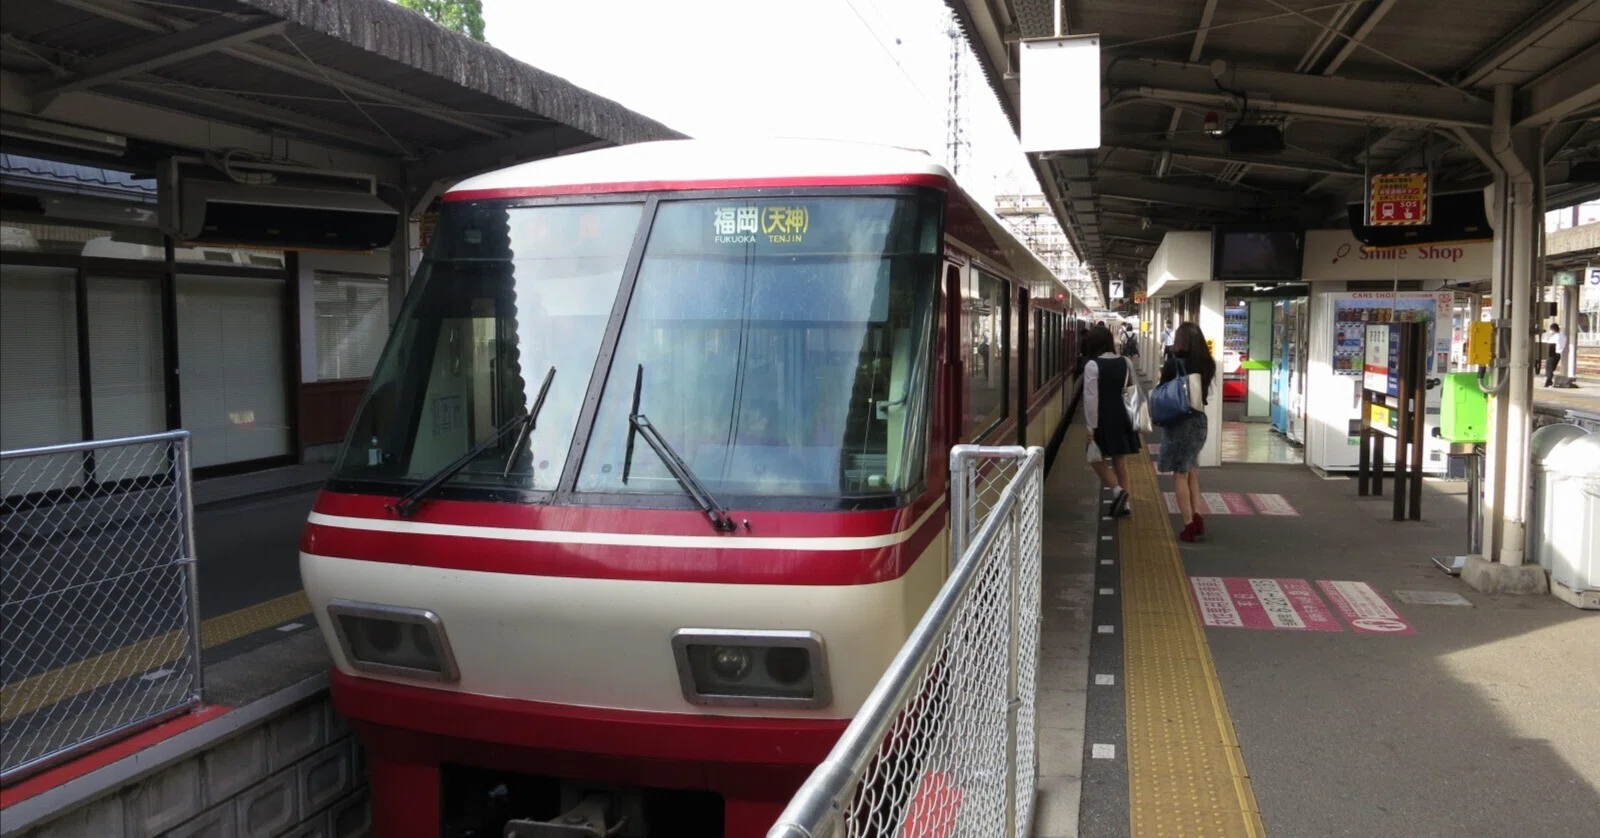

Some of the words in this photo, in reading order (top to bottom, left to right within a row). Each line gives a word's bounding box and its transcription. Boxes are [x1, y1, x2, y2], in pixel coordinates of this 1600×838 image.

[714, 206, 809, 234] 福岡(天神)
[714, 235, 757, 243] FUKUOKA
[1418, 246, 1464, 262] Shop
[1590, 270, 1600, 285] 5
[1112, 282, 1121, 295] 7
